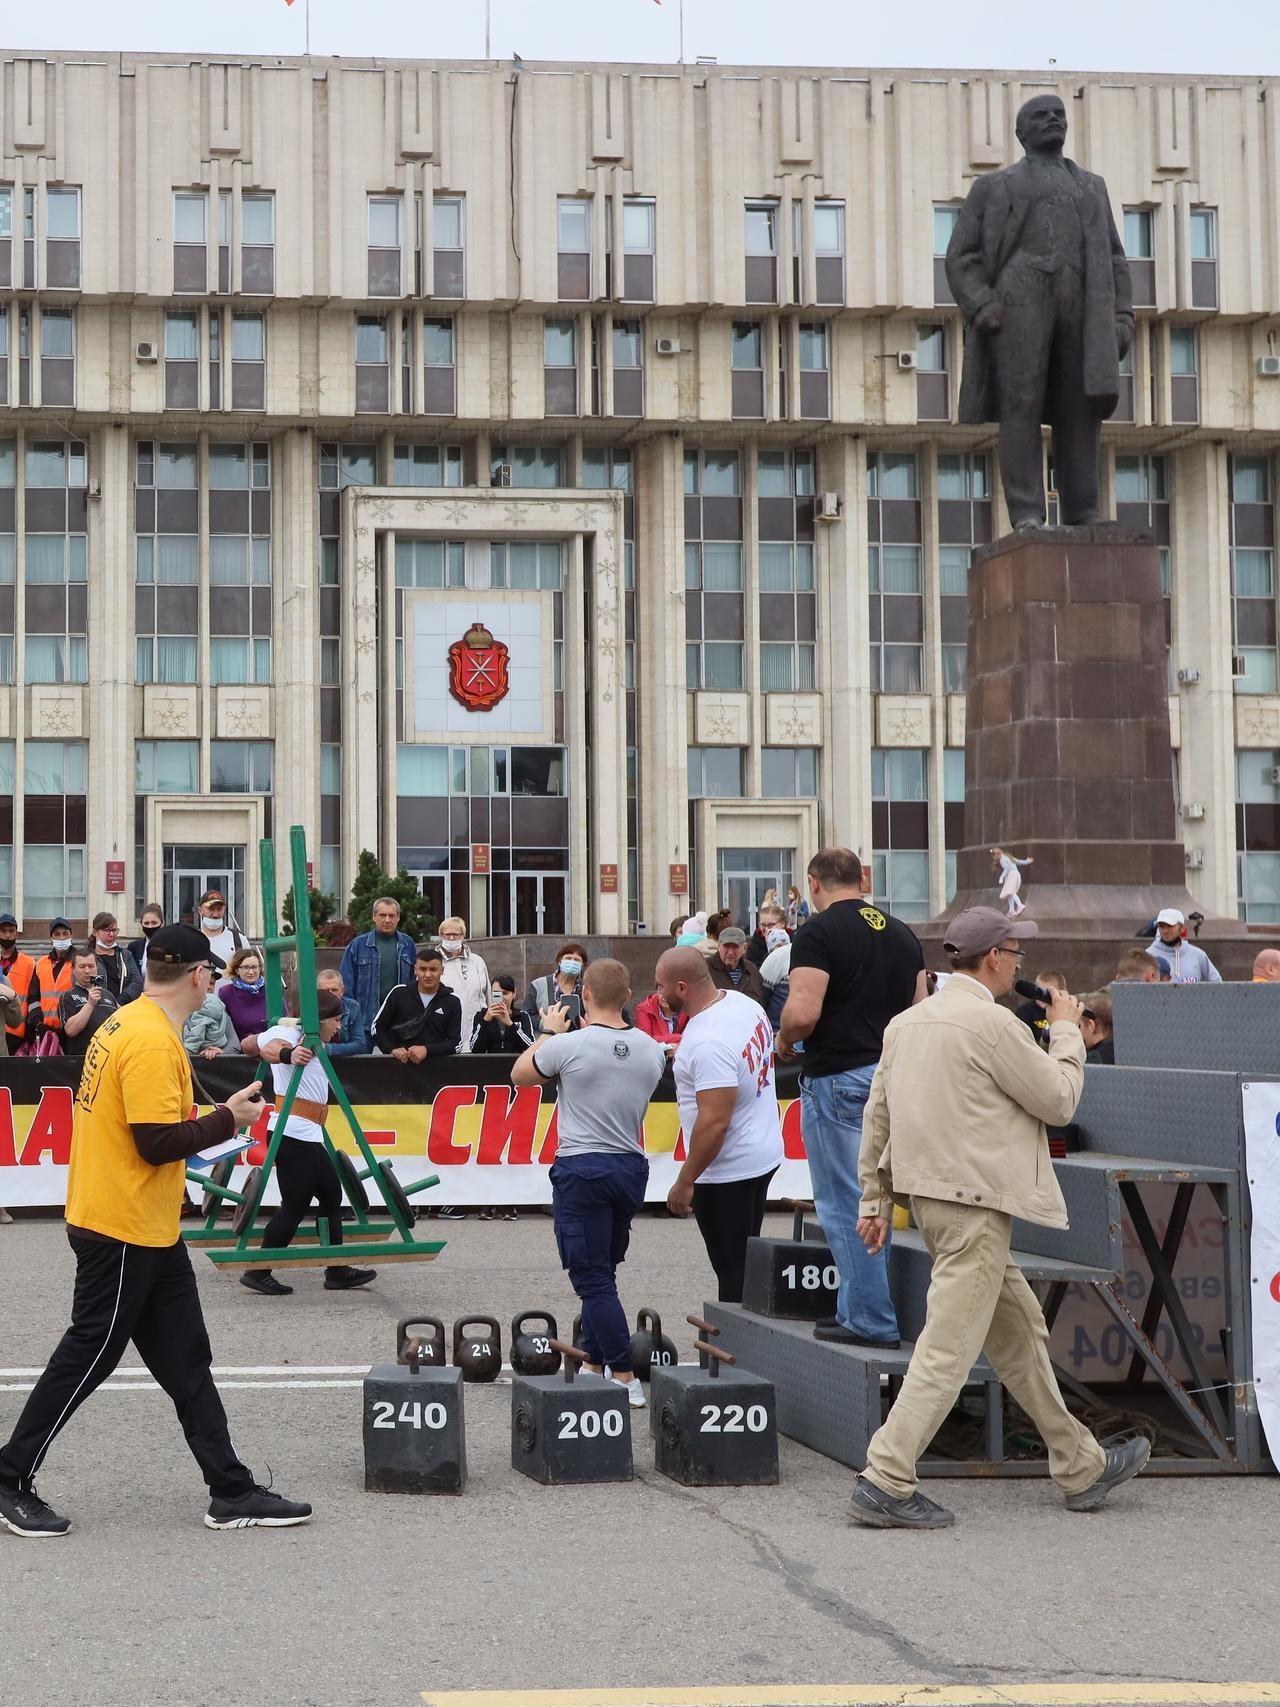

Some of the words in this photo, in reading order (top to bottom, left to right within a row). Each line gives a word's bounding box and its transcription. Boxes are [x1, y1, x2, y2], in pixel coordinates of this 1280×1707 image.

[781, 1264, 842, 1291] 180
[417, 1343, 434, 1358] 24
[471, 1343, 492, 1357] 24
[532, 1337, 553, 1354] 32
[650, 1350, 671, 1366] 40
[372, 1401, 448, 1430] 240
[557, 1409, 624, 1440] 200
[699, 1404, 768, 1433] 220
